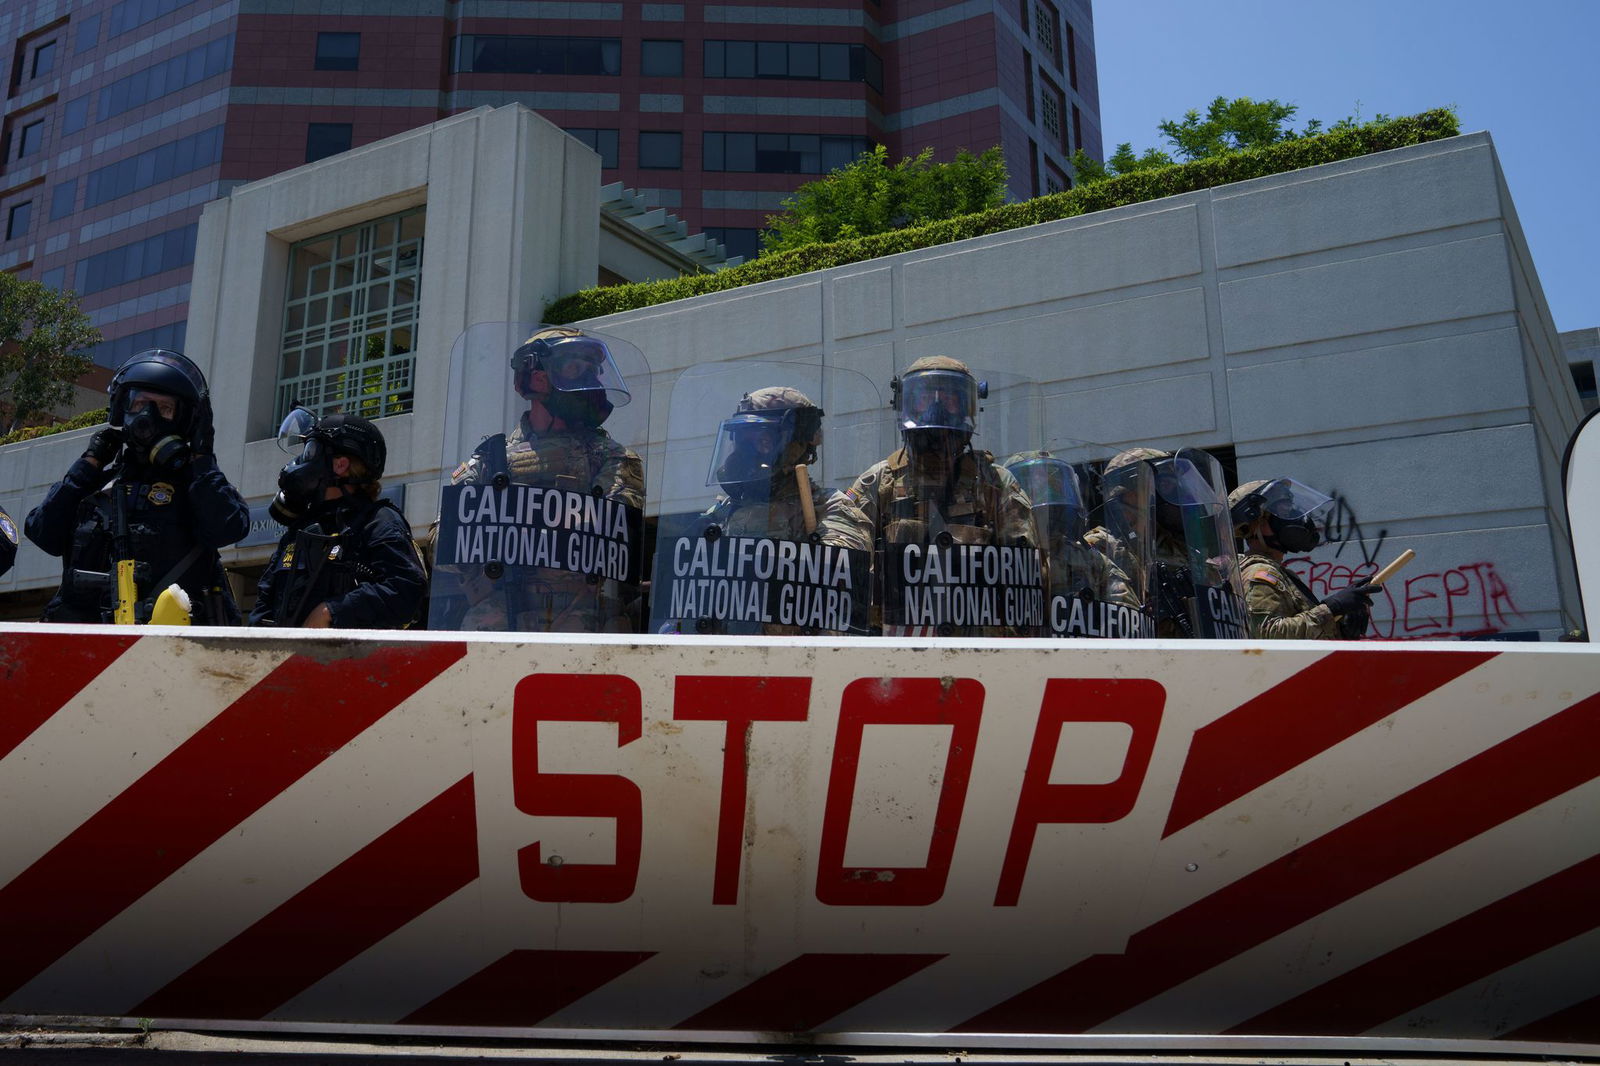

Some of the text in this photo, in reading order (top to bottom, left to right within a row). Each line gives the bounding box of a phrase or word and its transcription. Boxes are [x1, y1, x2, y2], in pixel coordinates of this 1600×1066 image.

[457, 485, 630, 542] CALIFORNIA
[454, 525, 629, 583] NATIONAL GUARD
[673, 536, 852, 589] CALIFORNIA
[902, 543, 1043, 587] CALIFORNIA
[670, 579, 853, 632] NATIONAL GUARD
[904, 585, 1044, 627] NATIONAL GUARD
[512, 673, 1166, 907] STOP
